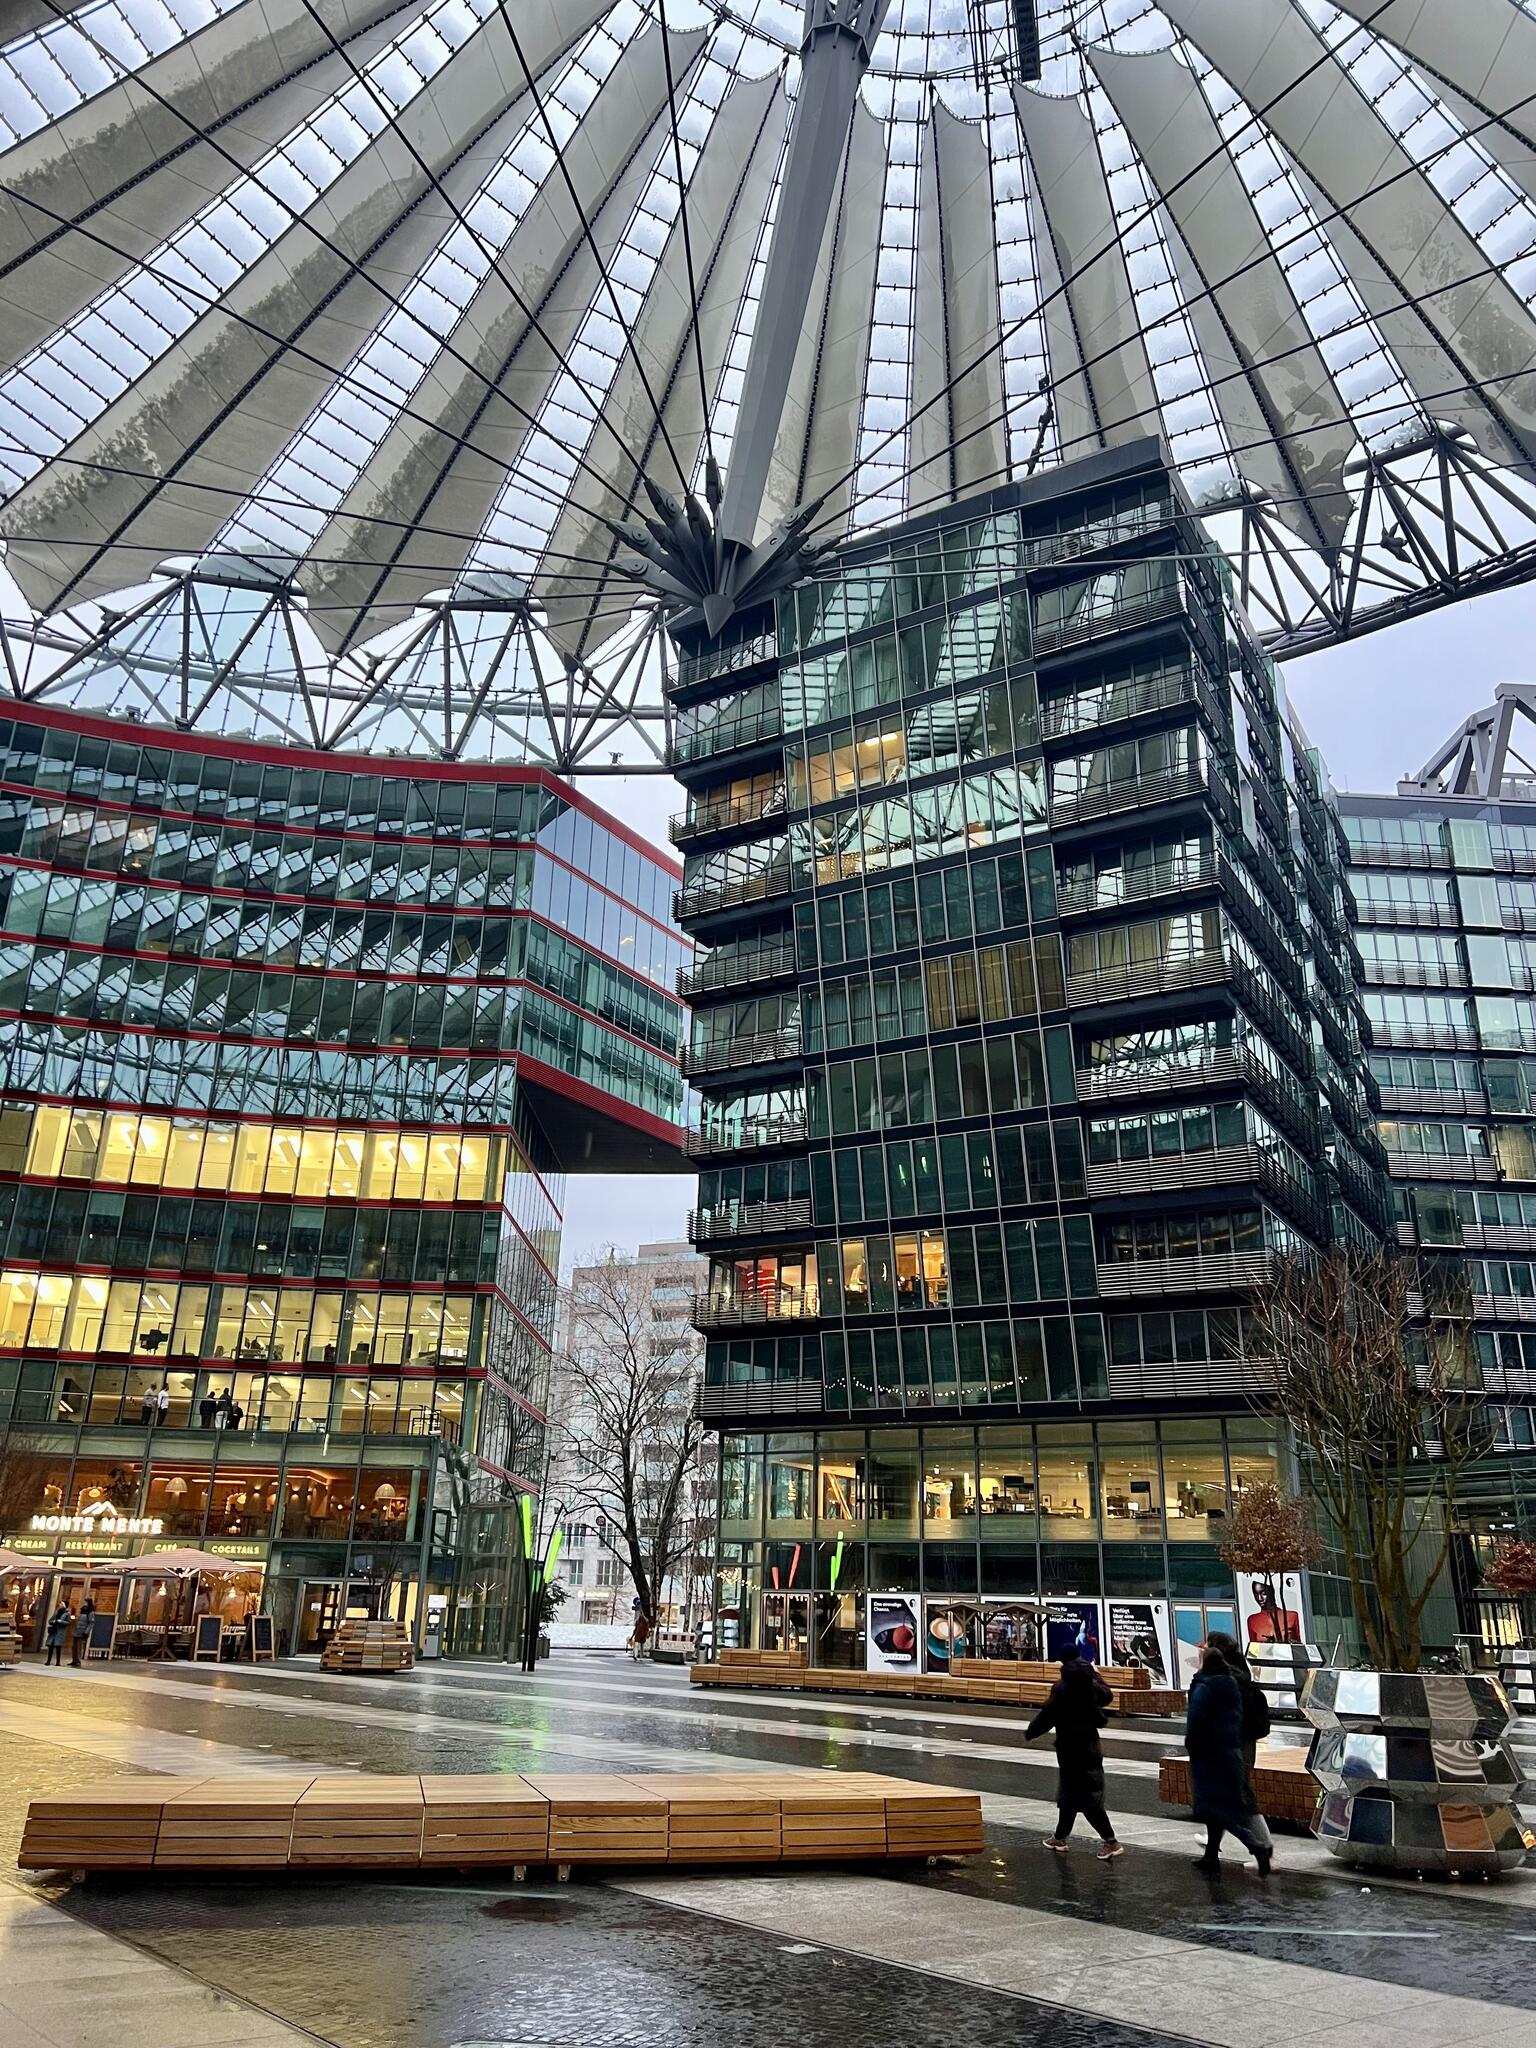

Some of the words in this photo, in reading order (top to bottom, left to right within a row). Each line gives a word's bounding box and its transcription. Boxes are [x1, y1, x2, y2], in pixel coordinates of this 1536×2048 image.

[32, 1515, 95, 1532] MONTE
[102, 1518, 163, 1534] MENTE
[14, 1540, 47, 1549] CREAM
[65, 1542, 123, 1551] RESTAURANT
[211, 1545, 260, 1555] COCKTAILS
